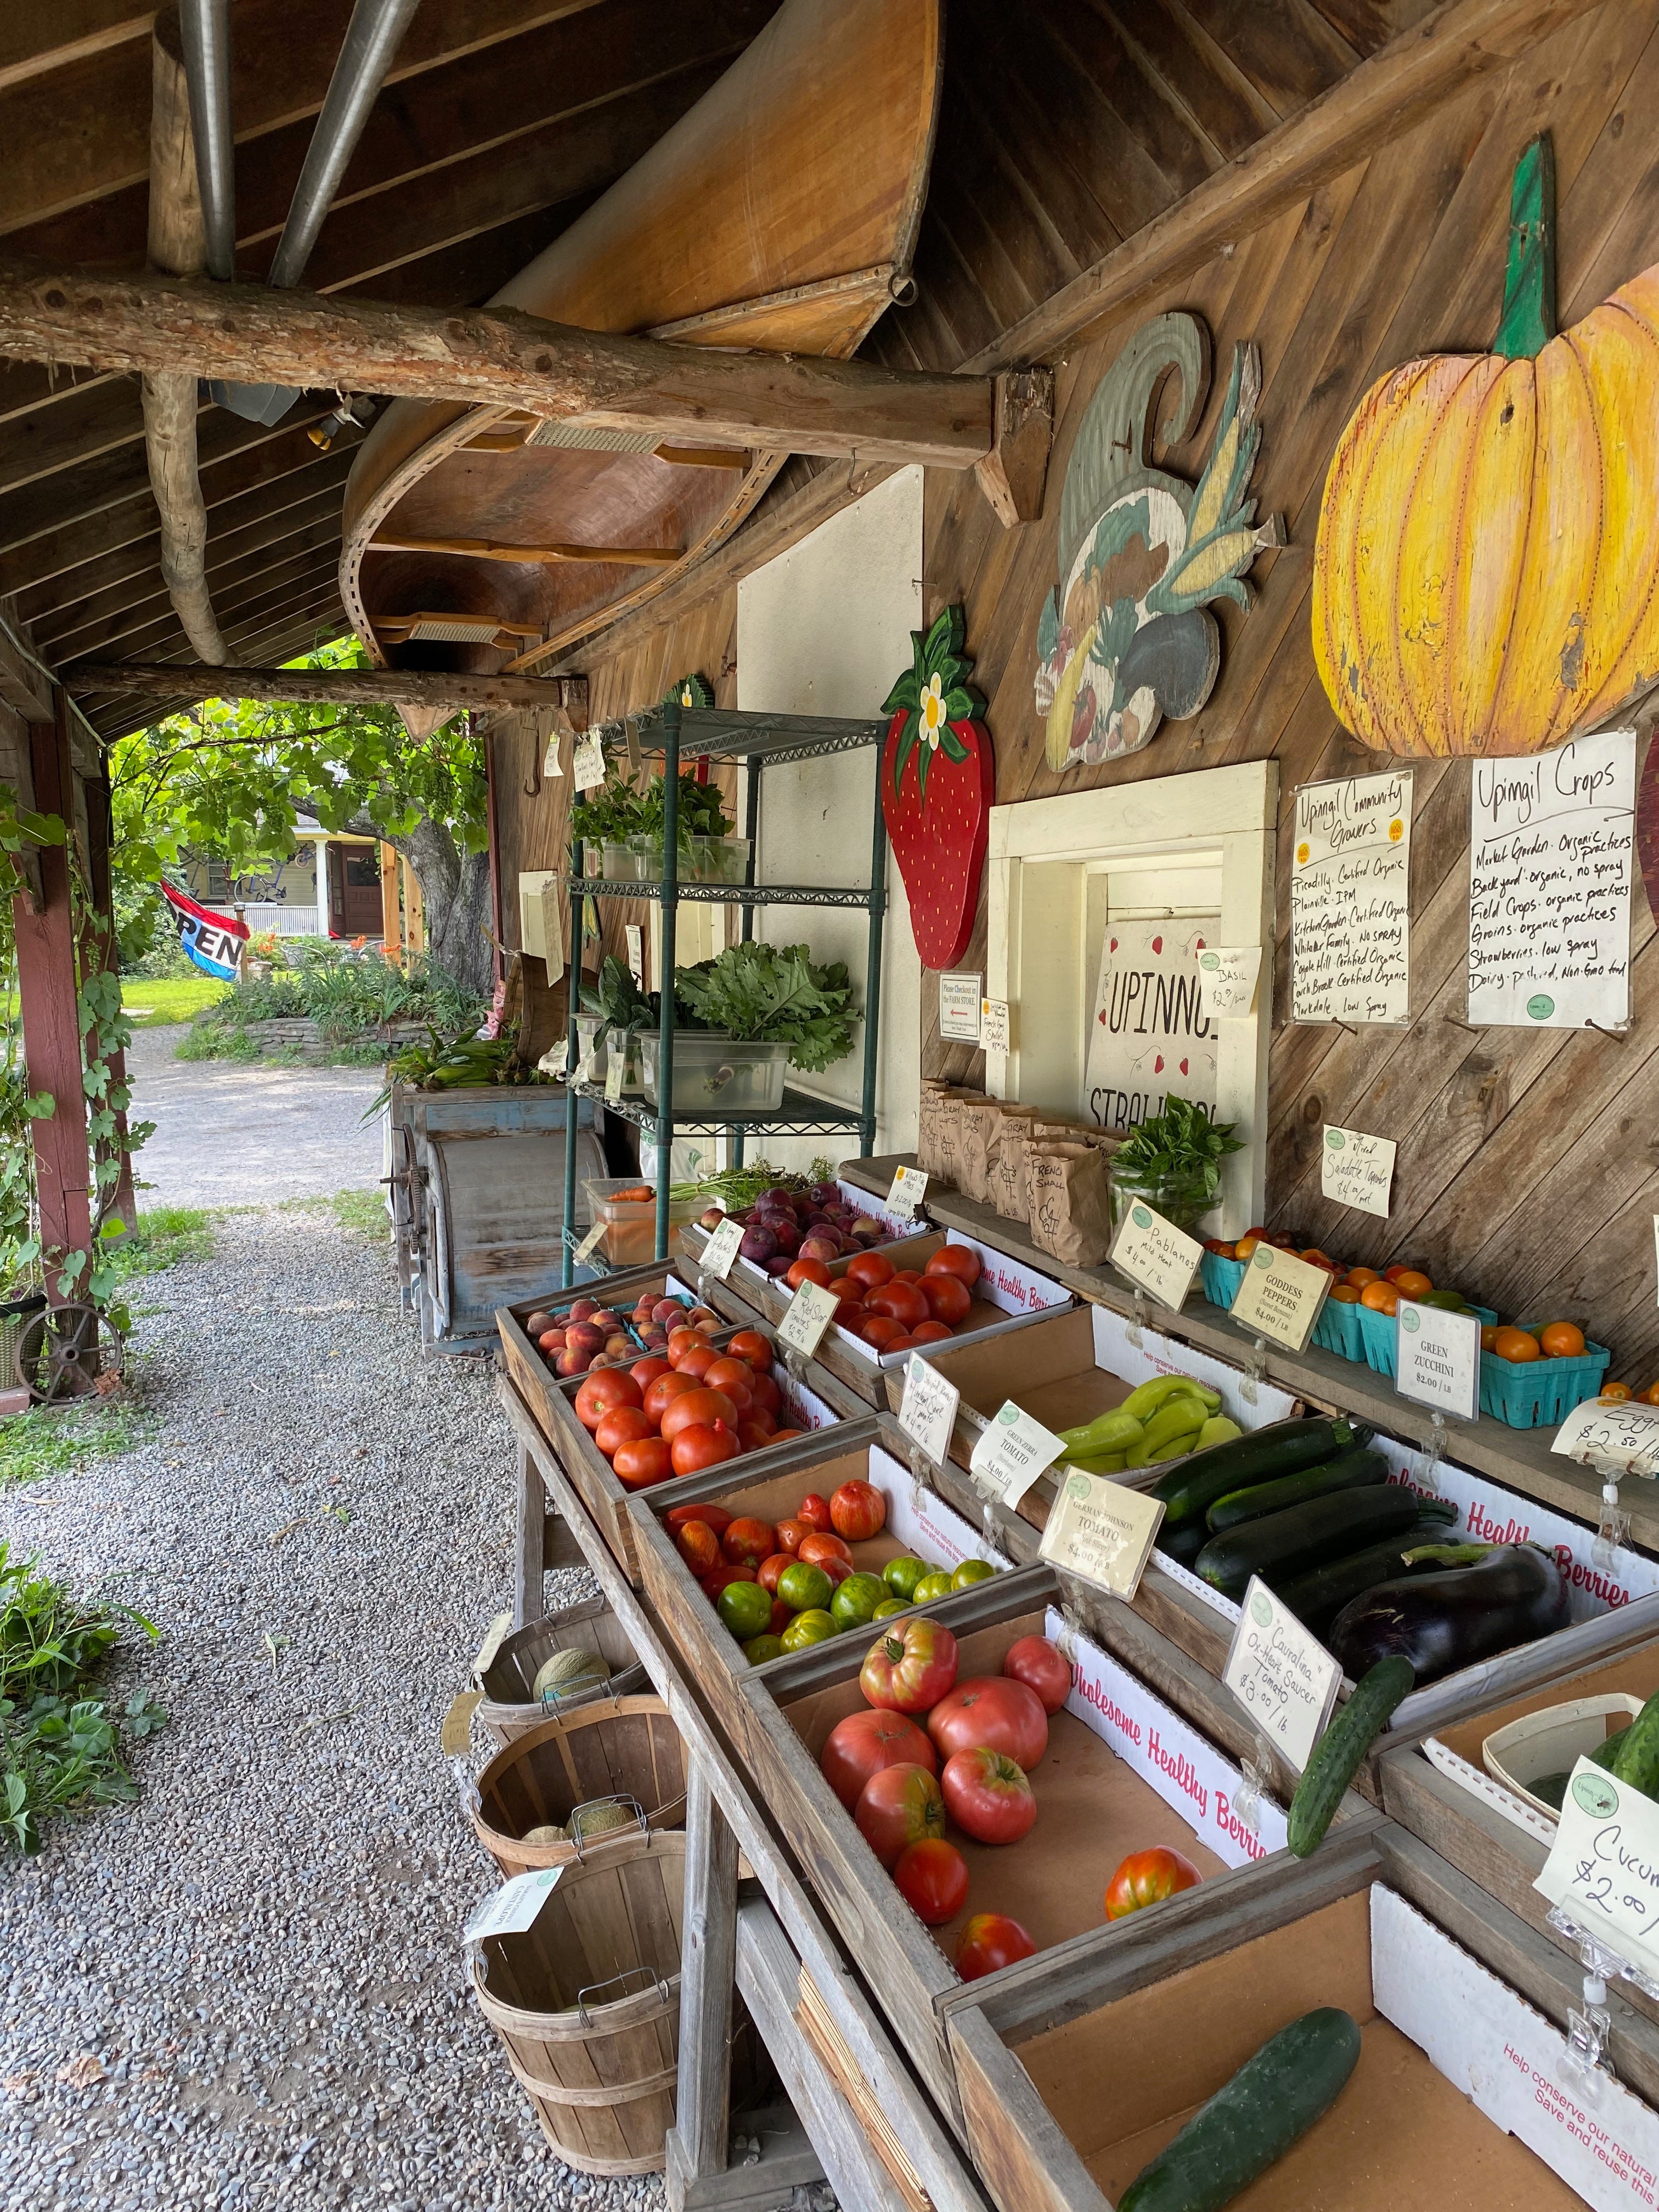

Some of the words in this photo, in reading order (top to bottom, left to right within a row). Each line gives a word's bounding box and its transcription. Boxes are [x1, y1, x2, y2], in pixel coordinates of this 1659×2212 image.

[1555, 742, 1615, 804] Crops
[1345, 778, 1402, 821] Community
[1330, 818, 1376, 853] Growers
[1581, 832, 1631, 862] practices
[1476, 845, 1508, 871] Market
[1559, 831, 1601, 861] Organic
[1339, 860, 1369, 884] Certified
[1374, 857, 1404, 879] Organic
[1577, 865, 1589, 877] no
[1593, 859, 1623, 880] spray
[1336, 888, 1356, 905] IPM
[1471, 899, 1500, 922] Field
[1546, 893, 1583, 913] organic
[1585, 883, 1629, 907] practices
[1350, 899, 1387, 927] Certified
[1520, 918, 1558, 939] organic
[1562, 907, 1617, 933] practices
[1359, 929, 1370, 943] NO
[1373, 927, 1402, 946] SPRAY
[1542, 941, 1561, 957] low
[1567, 939, 1598, 960] spray
[1336, 947, 1369, 968] Certified
[1370, 947, 1404, 970] Organic
[944, 984, 954, 992] Please
[955, 985, 972, 994] Checkout
[1216, 970, 1246, 982] BASIL
[1338, 968, 1373, 986] Certified
[1375, 969, 1407, 986] Organic
[949, 996, 961, 1005] FARM
[1343, 997, 1359, 1013] Low
[1366, 996, 1387, 1020] Spray
[1006, 1119, 1028, 1132] GRAY
[1141, 1242, 1155, 1255] Mild
[1158, 1254, 1172, 1268] Heat
[1150, 1228, 1195, 1269] Pablanos
[997, 1269, 1026, 1307] Healthy
[1262, 1286, 1297, 1311] PEPPERS
[1266, 1274, 1303, 1299] GODDESS
[802, 1297, 815, 1316] Red
[1255, 1307, 1276, 1324] $4.00
[1281, 1323, 1289, 1331] LB
[1259, 1299, 1273, 1310] (Sweet
[1273, 1306, 1293, 1320] Banana)
[1421, 1340, 1448, 1358] GREEN
[1144, 1351, 1154, 1362] Help
[1154, 1357, 1173, 1370] conserve
[1182, 1371, 1199, 1382] natural
[1199, 1379, 1223, 1396] resources.
[1156, 1365, 1167, 1375] Save
[1414, 1355, 1454, 1378] ZUCCHINI
[1416, 1373, 1437, 1388] $2.00
[1444, 1384, 1451, 1393] LB
[1000, 1438, 1029, 1465] TOMATO
[1007, 1430, 1023, 1444] GREEN
[1022, 1443, 1038, 1457] ZEBRA
[1576, 1422, 1637, 1454] $2.50
[987, 1460, 1003, 1478] $4.00
[1005, 1478, 1012, 1487] LB
[1073, 1500, 1102, 1517] GERMAN
[1102, 1513, 1135, 1532] JOHNSON
[1078, 1516, 1119, 1542] TOMATO
[919, 1514, 934, 1530] conserve
[940, 1532, 952, 1548] natural
[919, 1521, 928, 1534] Save
[936, 1538, 945, 1550] reuse
[1068, 1543, 1093, 1562] $4.00
[1248, 1633, 1282, 1675] Ox-Heart
[1284, 1670, 1316, 1705] Saucer
[1254, 1656, 1288, 1703] Tomato
[1240, 1674, 1271, 1707] $3.00
[1148, 1727, 1207, 1818] Healthy
[1573, 1860, 1645, 1914] $2.00
[1503, 2044, 1530, 2073] Help
[1532, 2072, 1585, 2123] conserve
[1588, 2122, 1610, 2145] our
[1611, 2142, 1657, 2188] natural
[1535, 2089, 1564, 2123] Save
[1567, 2121, 1592, 2147] and
[1593, 2144, 1628, 2180] reuse
[1631, 2177, 1655, 2204] this
